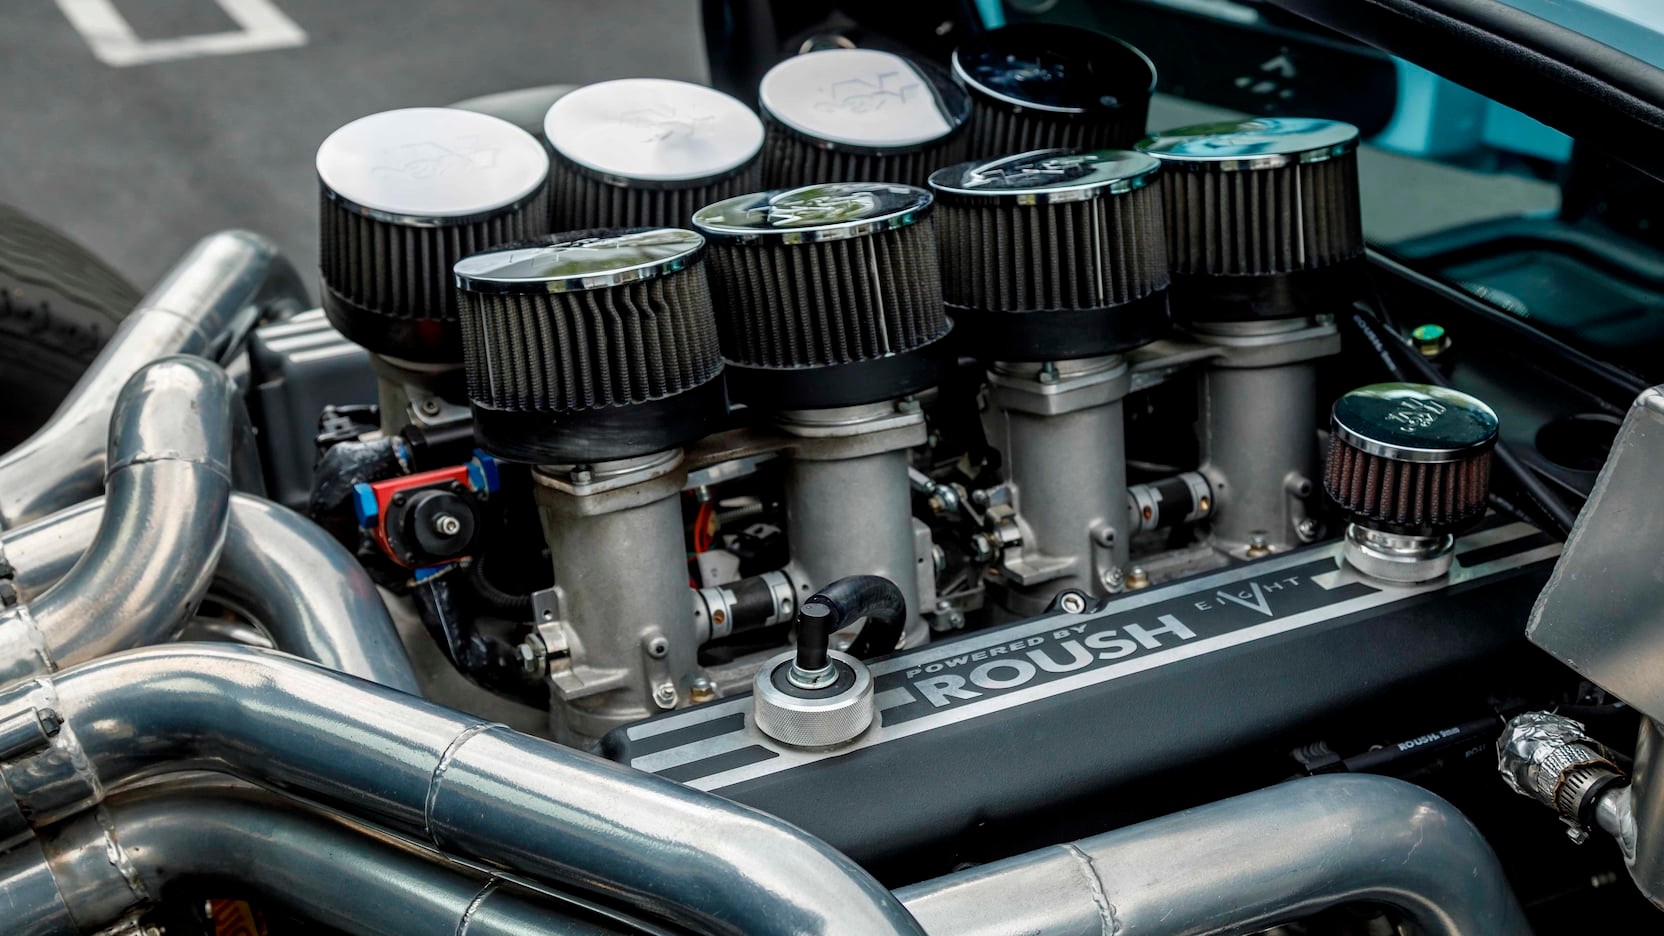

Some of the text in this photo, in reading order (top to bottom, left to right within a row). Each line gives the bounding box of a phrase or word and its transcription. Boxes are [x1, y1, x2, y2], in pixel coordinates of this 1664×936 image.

[907, 623, 1088, 680] POWERED BY
[913, 613, 1197, 708] ROUSH
